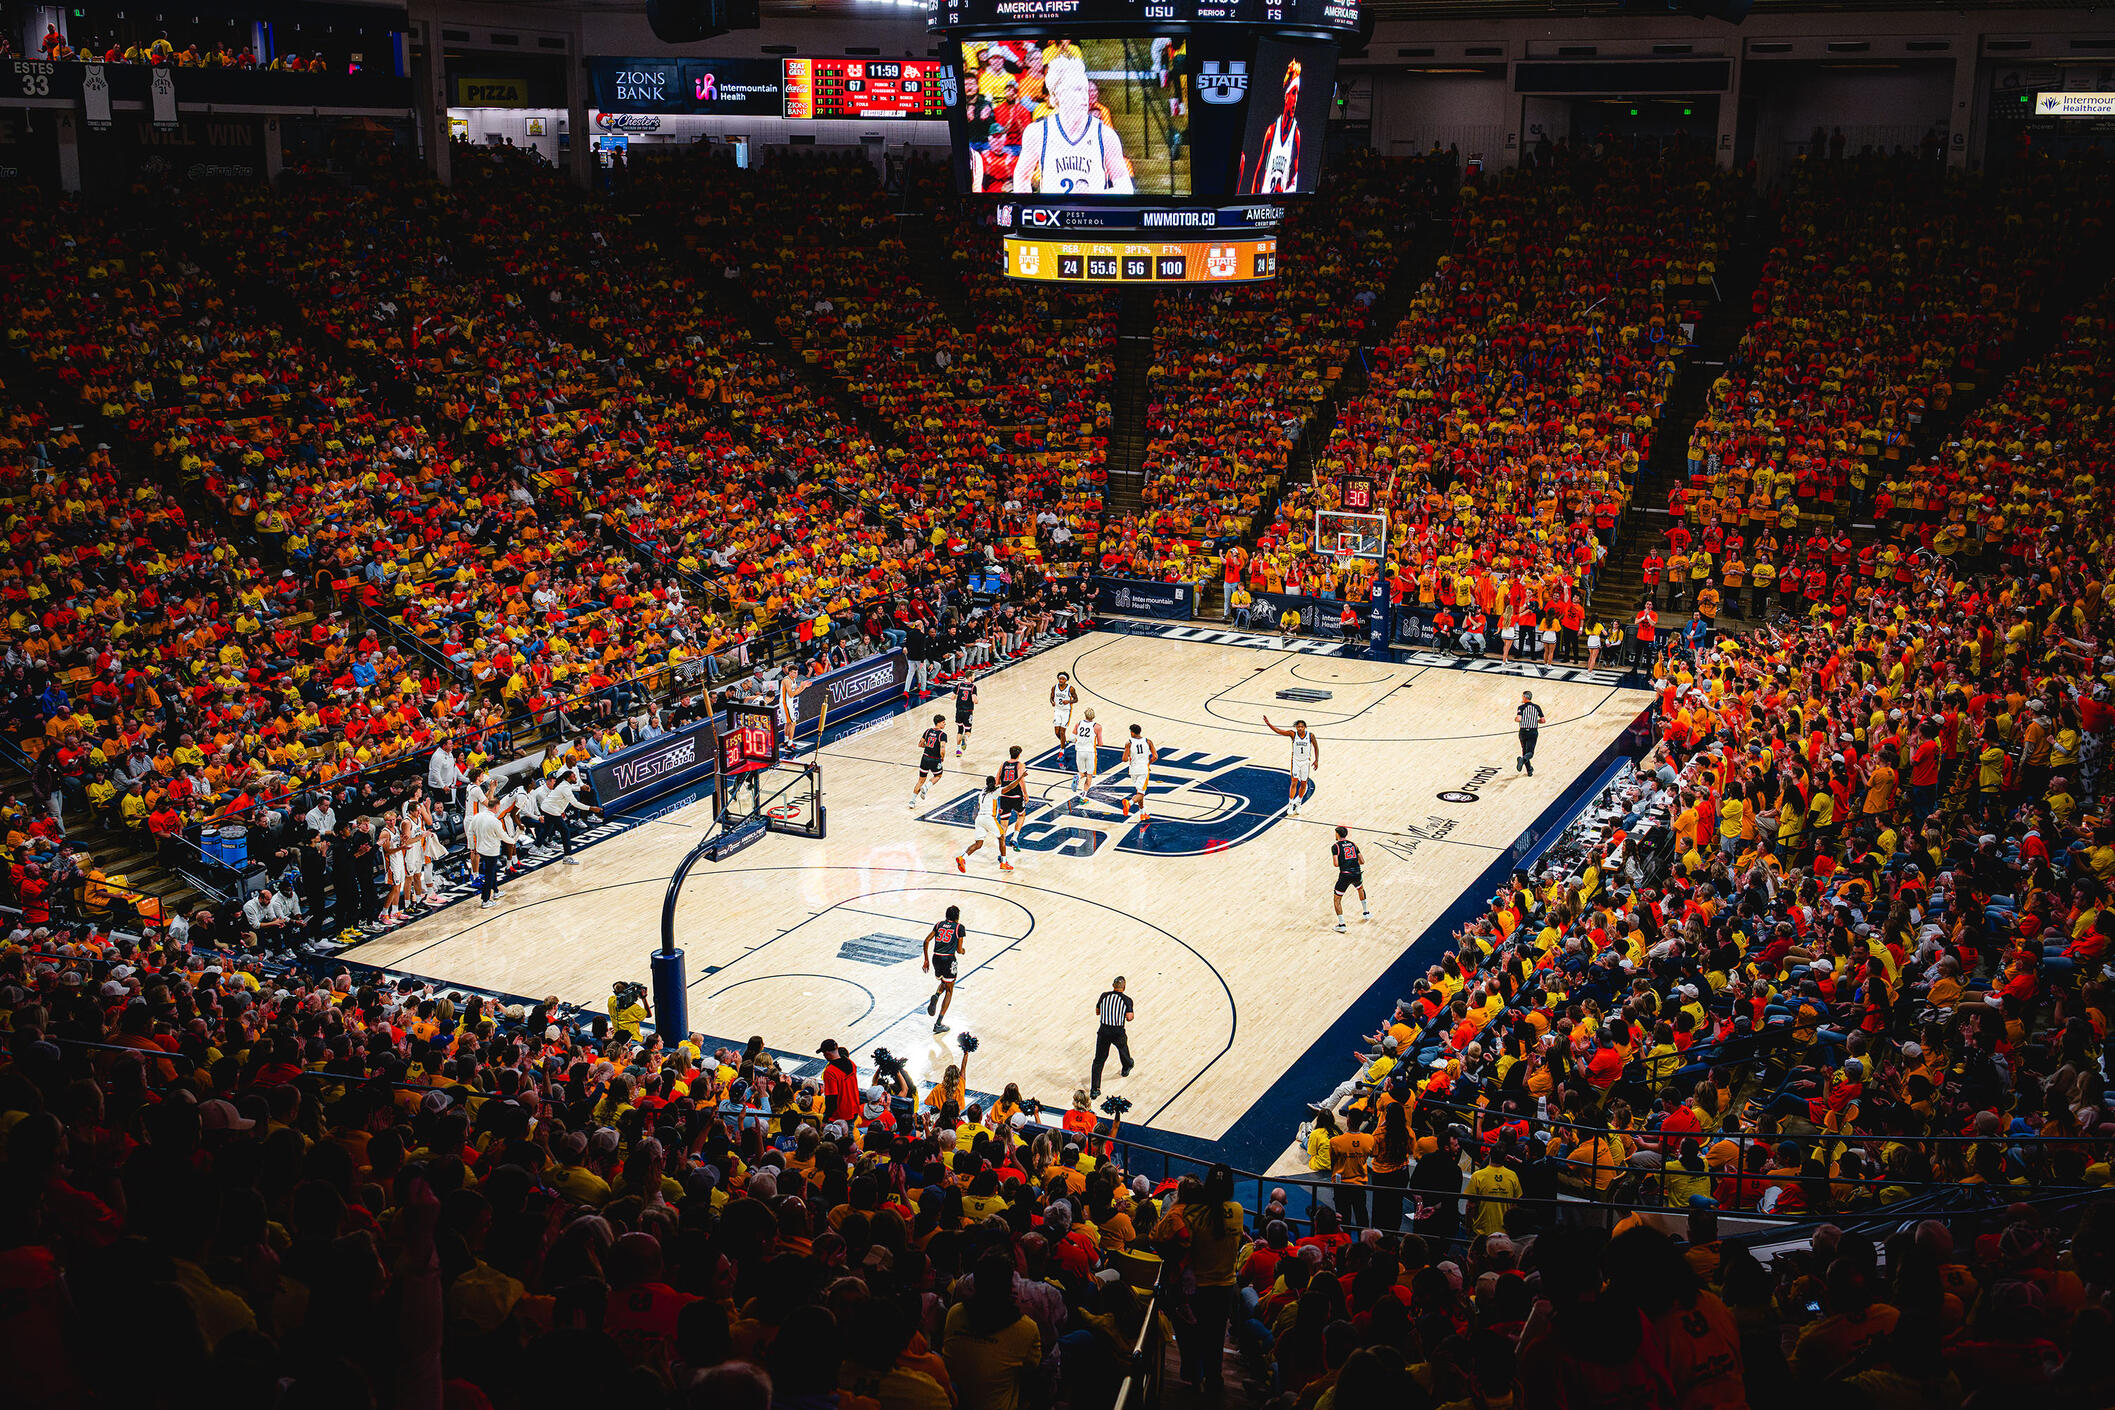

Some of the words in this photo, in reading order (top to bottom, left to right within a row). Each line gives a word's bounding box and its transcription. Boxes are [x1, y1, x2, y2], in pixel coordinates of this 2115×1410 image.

[997, 2, 1045, 14] AMERICA
[1046, 1, 1079, 12] FIRST
[1146, 7, 1173, 17] USU
[1230, 9, 1236, 17] 2
[1324, 6, 1351, 19] AMERICA
[949, 14, 959, 24] FS
[1268, 10, 1281, 20] FS
[14, 62, 55, 75] ESTES
[869, 64, 899, 77] 11:59
[154, 79, 172, 88] STATE
[616, 71, 665, 85] ZIONS
[1197, 73, 1248, 89] STATE
[22, 75, 50, 96] 33
[159, 86, 168, 95] 31
[720, 84, 778, 93] Intermountain
[849, 80, 861, 92] 67
[905, 81, 918, 92] 50
[468, 85, 519, 101] PIZZA
[617, 87, 665, 100] BANK
[720, 93, 746, 101] Health
[2063, 104, 2112, 112] Healthcare
[617, 113, 661, 127] Chester's
[137, 122, 197, 145] WILL
[207, 122, 252, 146] WIN
[1022, 209, 1061, 227] FOX
[1143, 212, 1216, 226] MWMOTOR.CO
[1063, 244, 1079, 253] REB
[1093, 245, 1113, 253] FG%
[1125, 245, 1151, 254] 3PT%
[1163, 245, 1182, 254] FT%
[1018, 256, 1040, 265] STATE
[1064, 260, 1077, 274] 24
[1207, 256, 1238, 266] STATE
[1257, 258, 1265, 272] 24
[1090, 261, 1117, 275] 55.6
[1128, 261, 1145, 275] 56
[1161, 261, 1182, 275] 100
[1349, 481, 1369, 491] 11:59
[1349, 490, 1367, 506] 30
[1131, 601, 1151, 610] Health
[1132, 595, 1174, 606] Intermountain
[1161, 625, 1347, 657] UTAH
[829, 672, 873, 703] WEST
[869, 674, 894, 690] MOTOR
[961, 690, 969, 701] 3
[739, 714, 769, 728] 11:59
[1079, 726, 1091, 738] 22
[725, 733, 742, 749] 11:59
[744, 729, 766, 755] 30
[926, 736, 937, 748] 17
[1136, 743, 1144, 755] 11
[665, 752, 696, 770] MOTOR
[727, 747, 739, 765] 30
[613, 745, 672, 790] WEST
[1003, 769, 1015, 781] 16
[1461, 766, 1503, 792] crumbl
[1431, 818, 1460, 840] COURT
[1344, 846, 1356, 860] 21
[936, 928, 954, 943] 35
